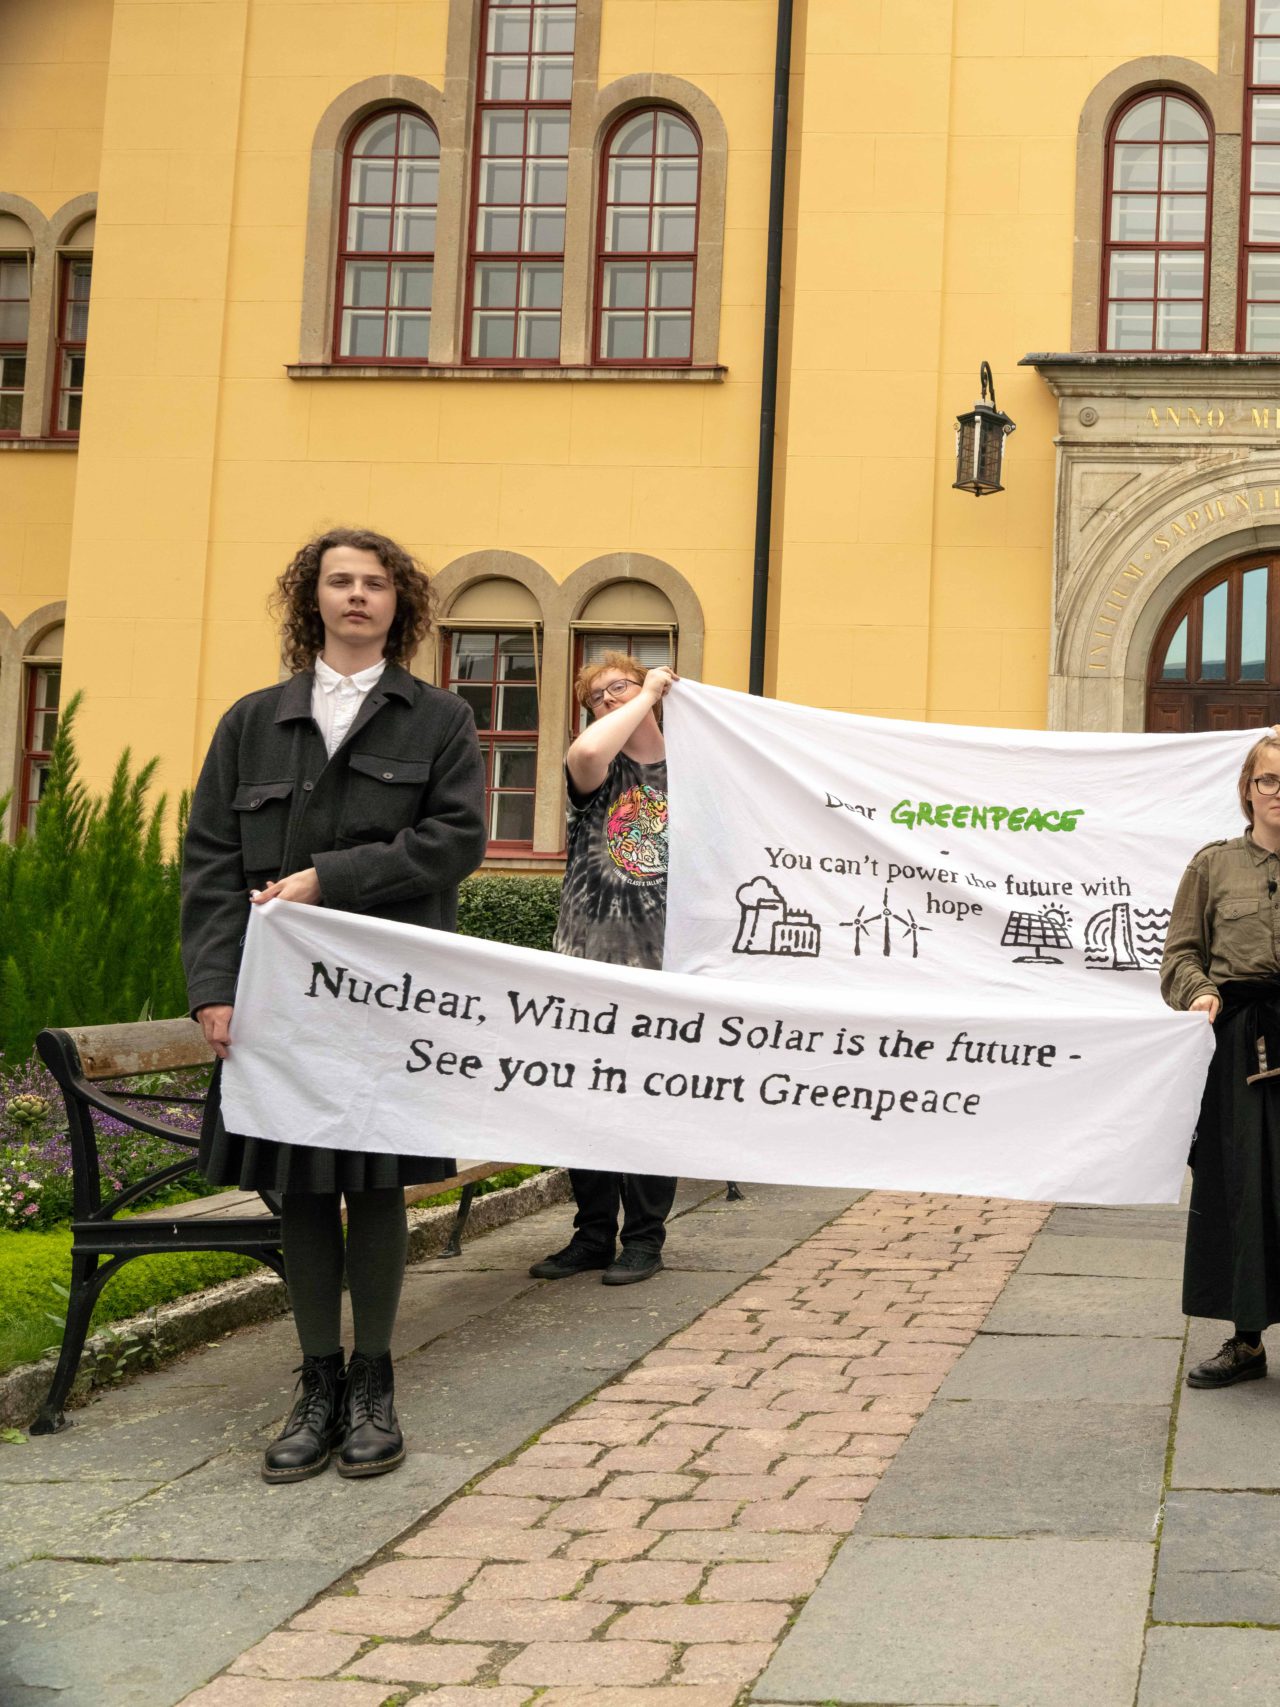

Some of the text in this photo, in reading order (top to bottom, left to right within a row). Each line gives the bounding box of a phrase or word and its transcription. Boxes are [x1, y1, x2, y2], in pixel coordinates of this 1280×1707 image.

[1145, 407, 1225, 429] ANNO
[825, 792, 1085, 832] Dear GREENPEACE
[764, 846, 1131, 898] You can't power the future with
[926, 892, 983, 921] hope
[305, 961, 485, 1026] Nuclear,
[508, 991, 618, 1034] Wind
[631, 1013, 704, 1043] and
[718, 1016, 824, 1053] Solar
[832, 1027, 865, 1056] is
[878, 1030, 935, 1060] the
[946, 1032, 1057, 1068] future
[406, 1039, 981, 1121] See you in court Greenpeace
